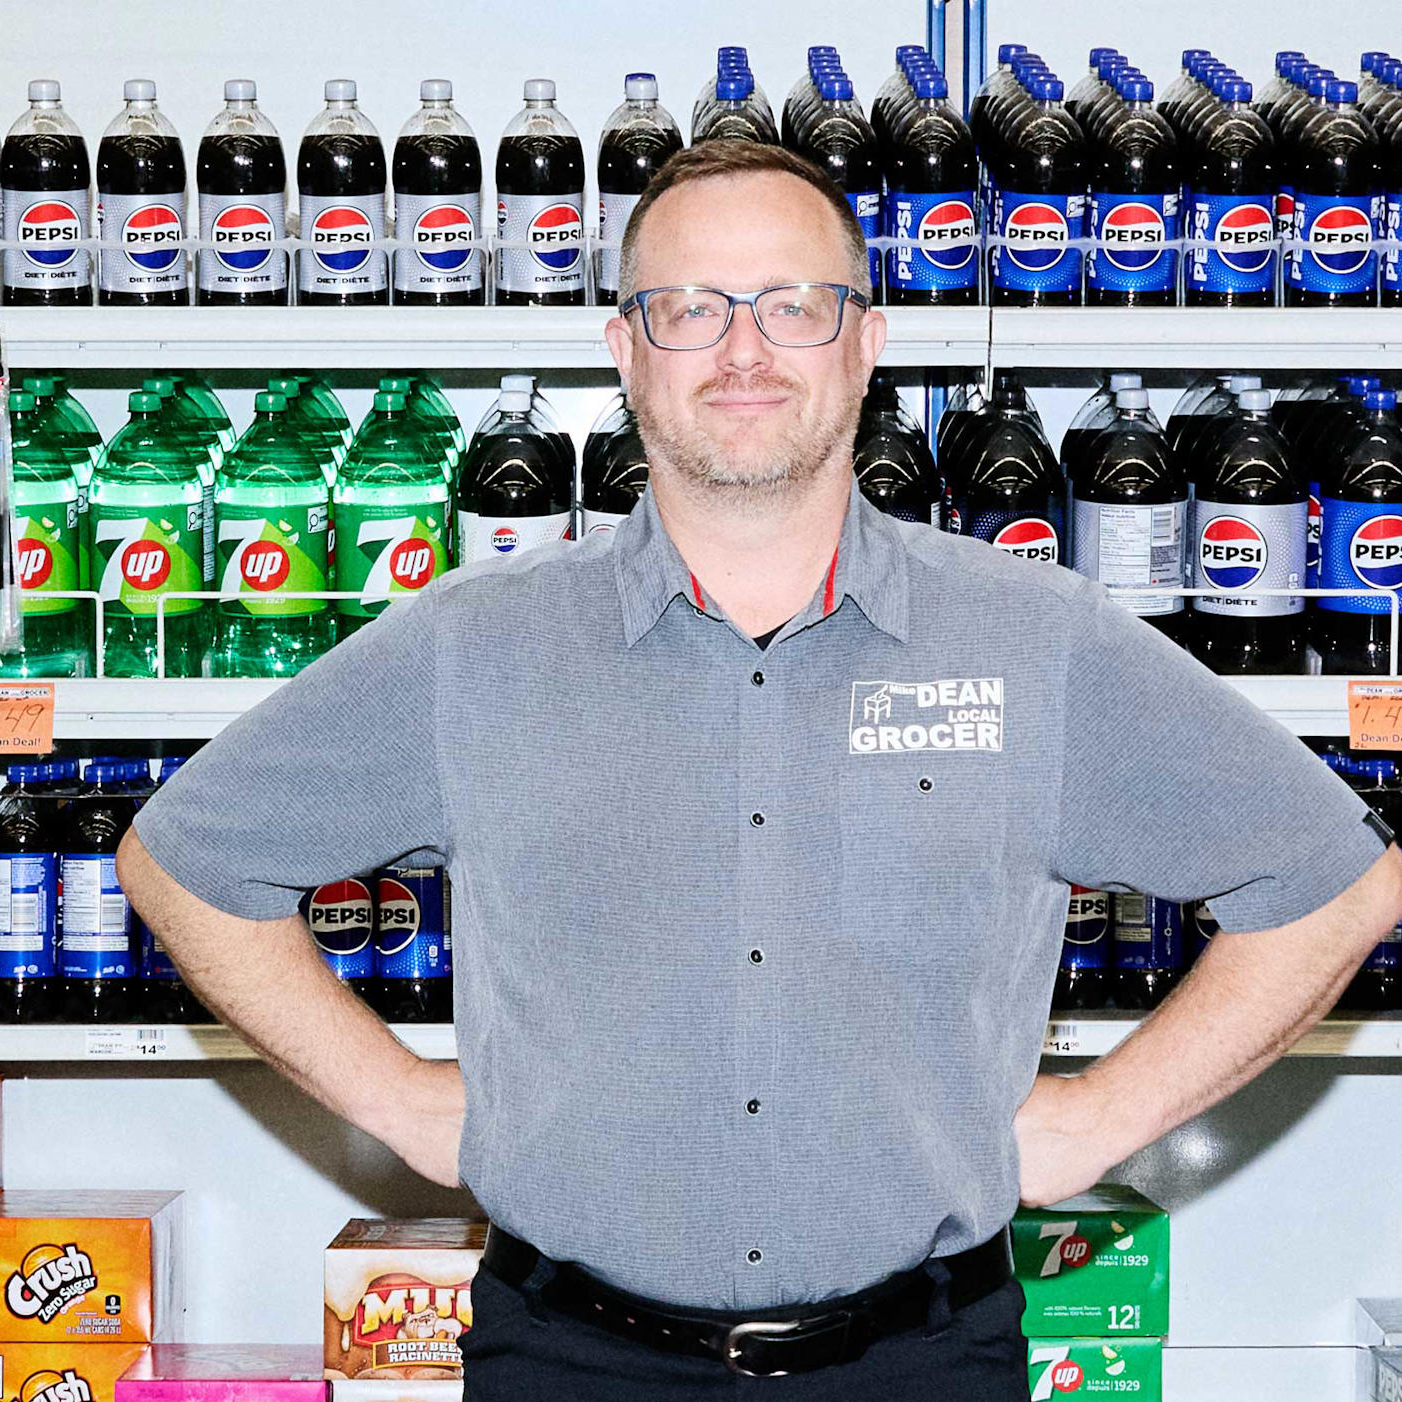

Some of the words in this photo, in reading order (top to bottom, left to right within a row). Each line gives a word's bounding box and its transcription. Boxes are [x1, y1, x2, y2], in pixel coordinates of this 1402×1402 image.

[1202, 544, 1261, 562] PEPSI
[916, 681, 1000, 708] DEAN
[949, 709, 1000, 723] LOCAL
[852, 723, 1000, 751] GROCER
[311, 906, 371, 924] PEPSI
[1122, 1255, 1149, 1266] 1929
[7, 1246, 92, 1316] Crush
[1108, 1305, 1134, 1330] 12
[387, 1342, 427, 1353] ROOT
[1114, 1379, 1141, 1391] 1929
